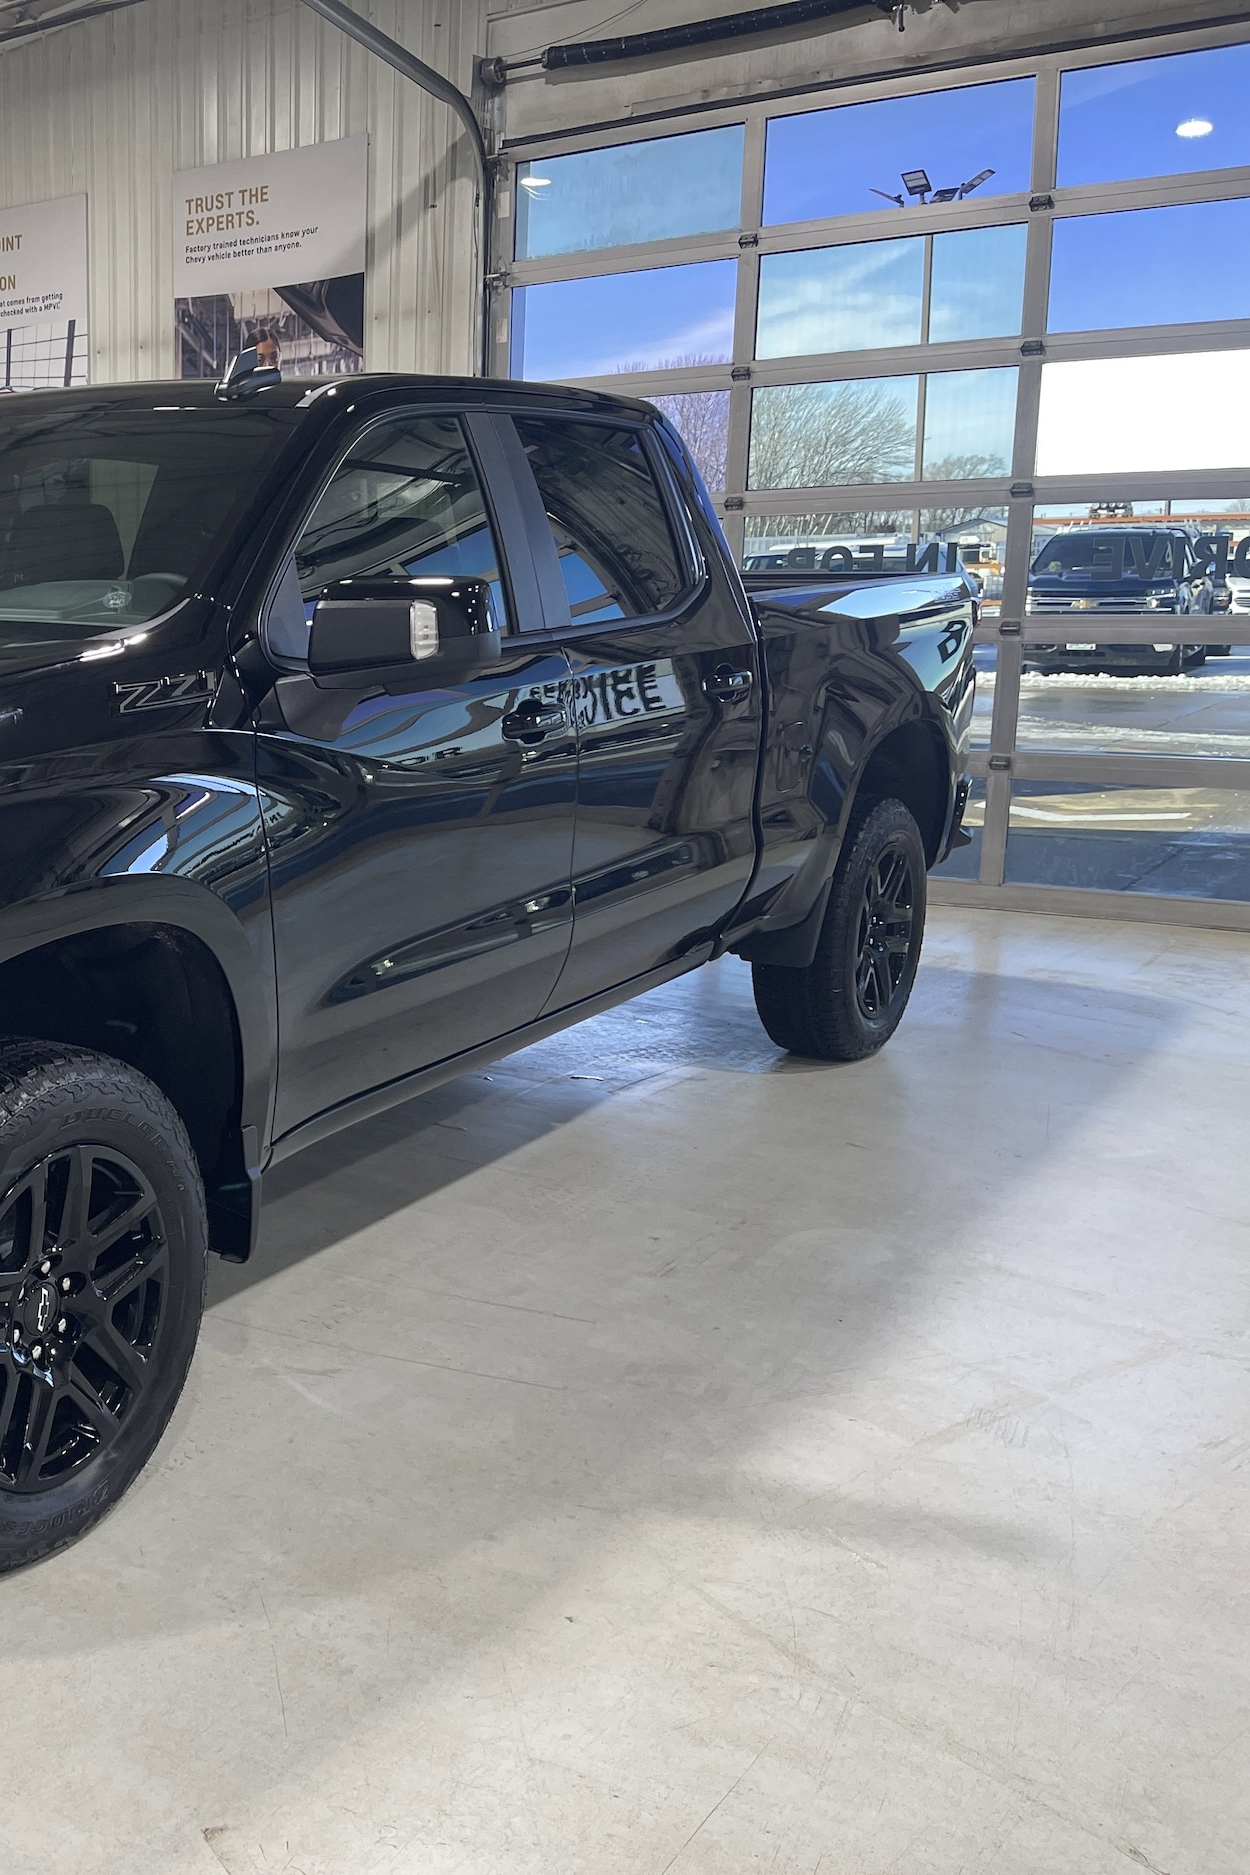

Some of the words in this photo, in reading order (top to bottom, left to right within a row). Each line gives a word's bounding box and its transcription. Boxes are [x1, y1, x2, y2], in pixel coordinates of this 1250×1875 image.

[185, 191, 234, 216] TRUST
[238, 185, 269, 206] THE
[185, 209, 260, 236] EXPERTS.
[185, 243, 212, 254] Factory
[213, 239, 238, 250] trained
[239, 234, 280, 247] technicians
[280, 230, 300, 240] know
[301, 226, 319, 238] your
[185, 253, 206, 264] Chevy
[207, 250, 231, 261] vehicle
[232, 247, 255, 258] better
[256, 244, 273, 255] than
[273, 240, 302, 253] anyone.
[0, 307, 24, 318] checked
[25, 305, 38, 314] with
[6, 298, 25, 307] comes
[26, 296, 40, 305] from
[41, 292, 63, 304] getting
[108, 669, 216, 717] Z71
